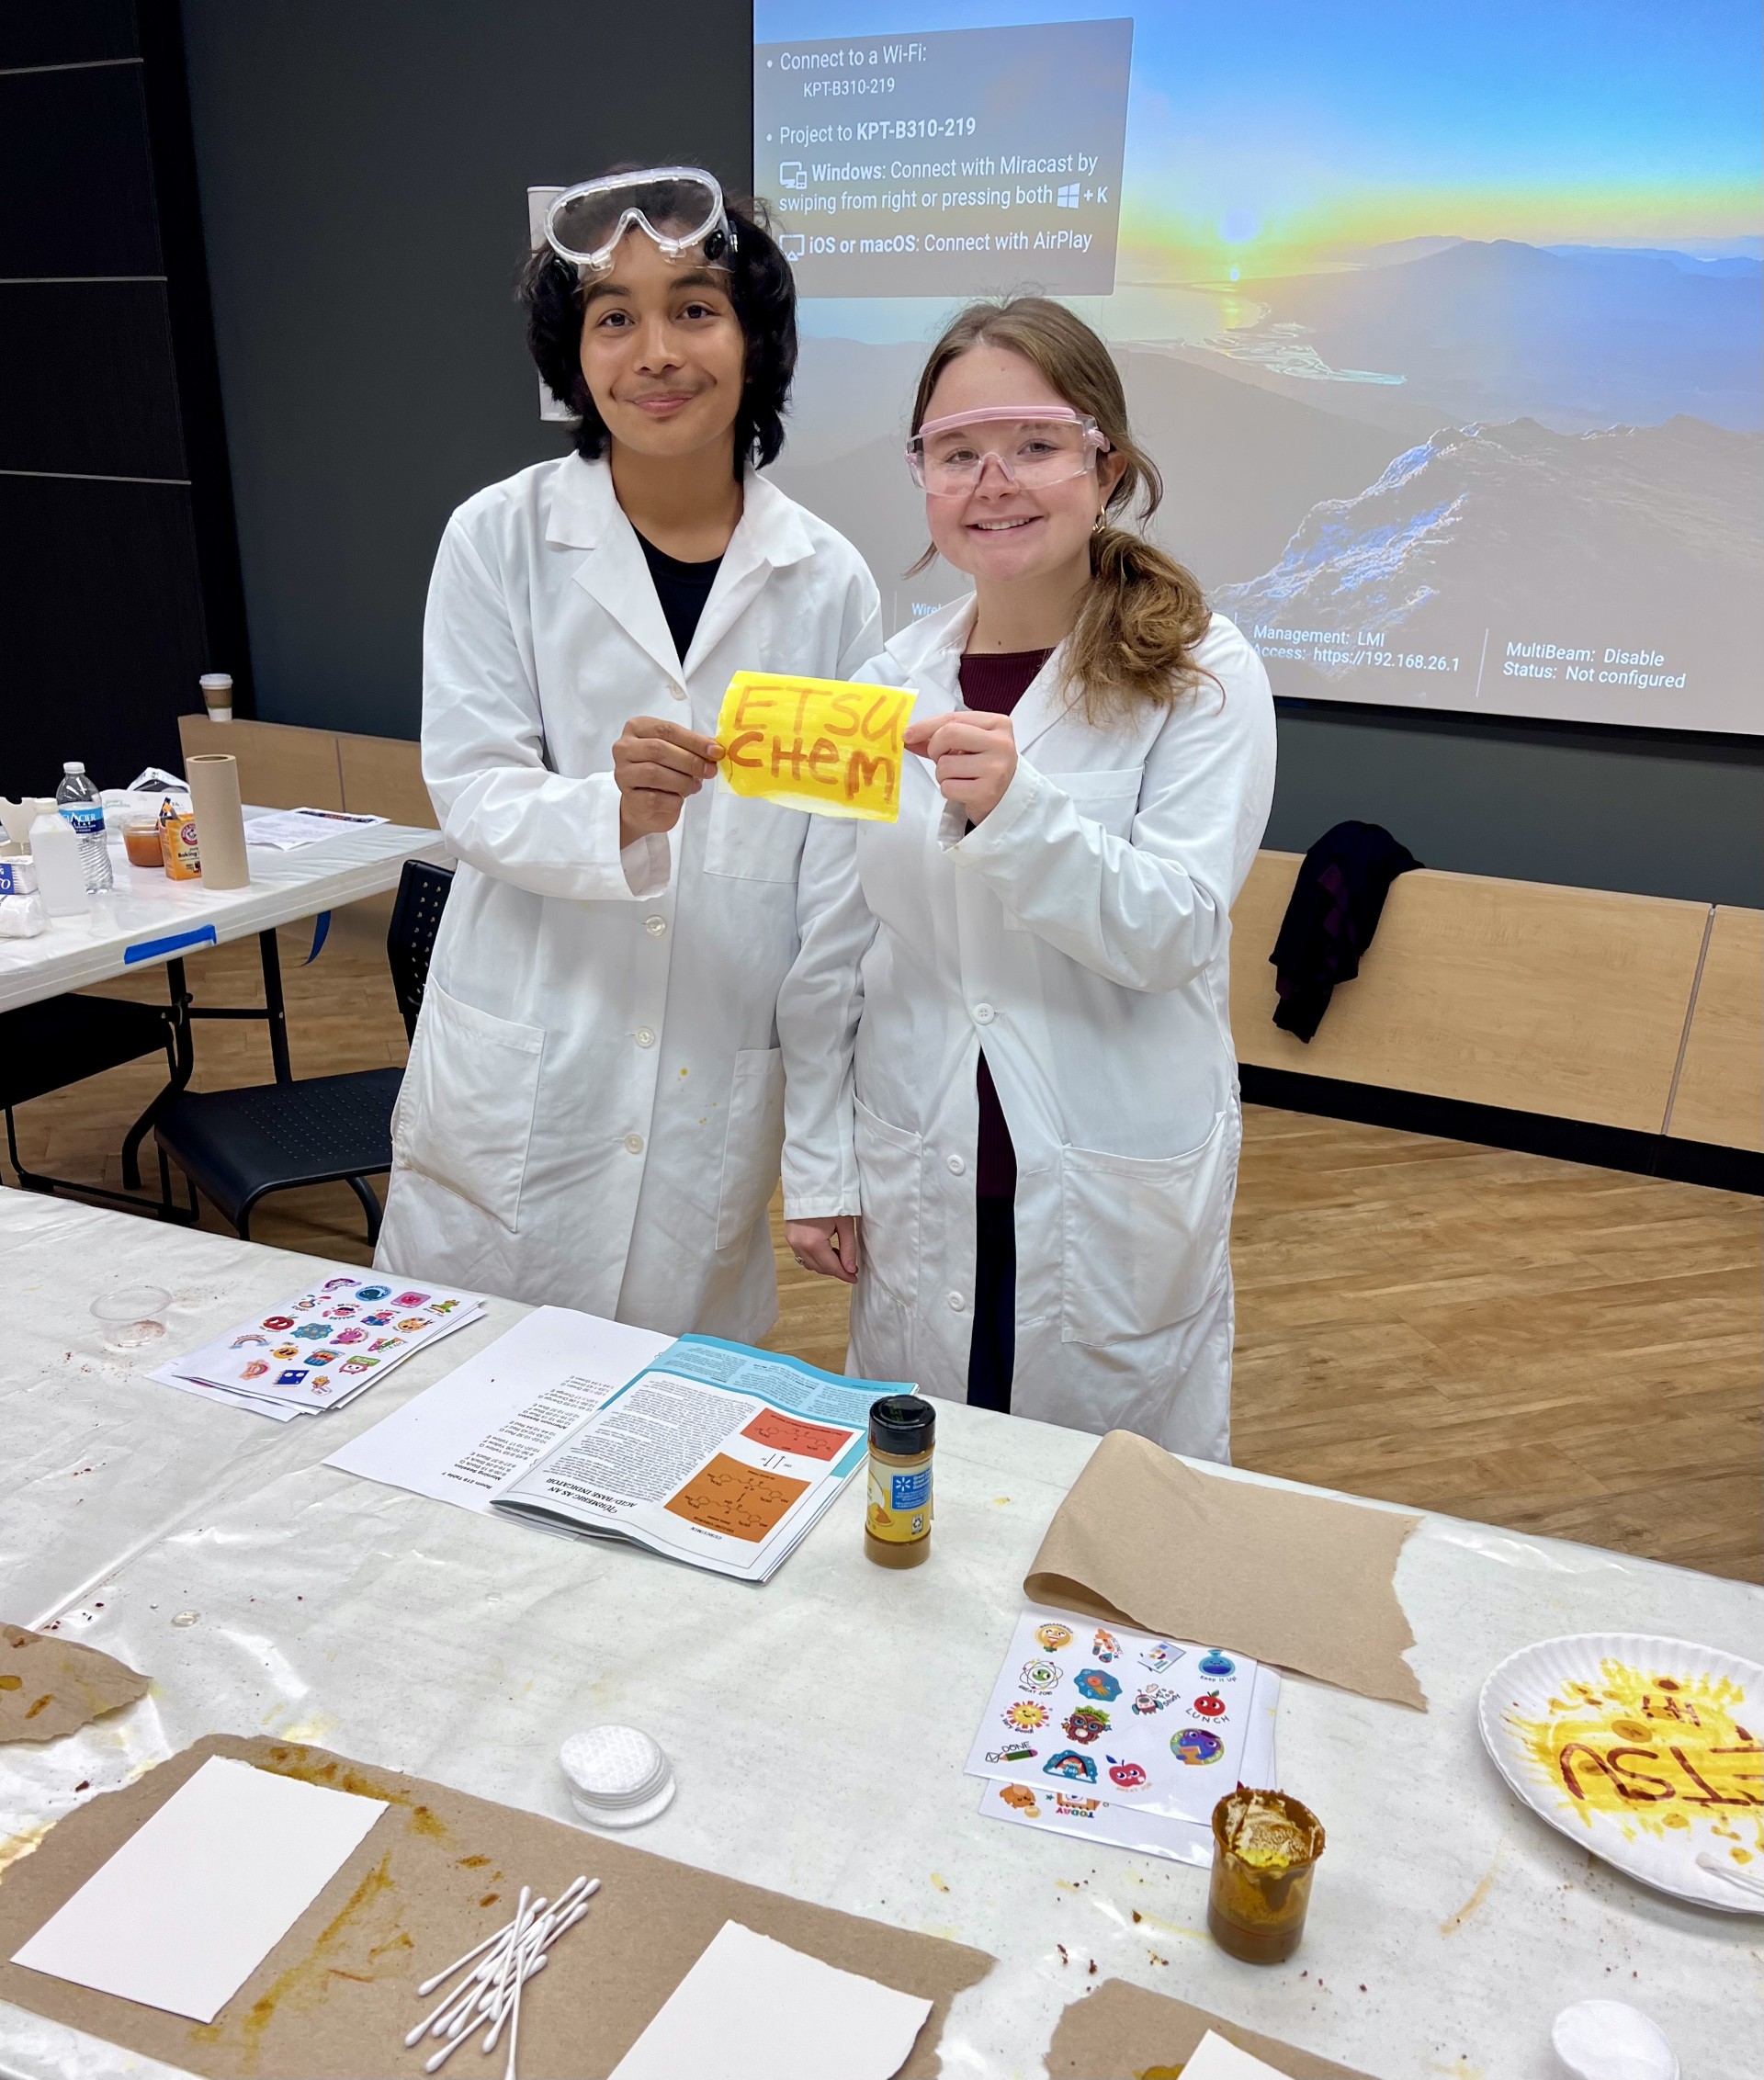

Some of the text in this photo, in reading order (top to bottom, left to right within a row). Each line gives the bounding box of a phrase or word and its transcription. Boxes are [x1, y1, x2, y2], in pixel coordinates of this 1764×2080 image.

[780, 43, 927, 70] Connect to a Wi-Fi:
[803, 77, 895, 97] KPT-B310-219
[780, 117, 976, 147] Project to KPT-B310-219
[811, 152, 1098, 182] Windows: Connect with Miracast by
[779, 193, 837, 215] swiping
[841, 190, 878, 209] from
[882, 188, 917, 212] right
[922, 193, 937, 208] or
[941, 187, 1011, 211] pressing
[1015, 185, 1053, 204] both
[1097, 187, 1108, 203] K
[809, 231, 1093, 254] iOS or macOS: Connect with AirPlay
[1254, 625, 1385, 647] Management: LMI
[1254, 644, 1459, 672] Access: https://192.168.26.1
[1506, 642, 1665, 667] MultiBeam: Disable
[1503, 661, 1687, 689] Status: Not configured
[733, 685, 907, 754] ETSU
[541, 1420, 567, 1429] Afternoon
[454, 1464, 501, 1480] Morning Session
[546, 1477, 590, 1494] INDICATOR
[547, 1486, 562, 1495] AN
[575, 1493, 618, 1514] TURMERIC
[690, 1526, 722, 1540] CURCUMIN
[1186, 1707, 1230, 1724] LUNCH
[1001, 1741, 1031, 1752] DONE
[1056, 1807, 1094, 1819] TODAY
